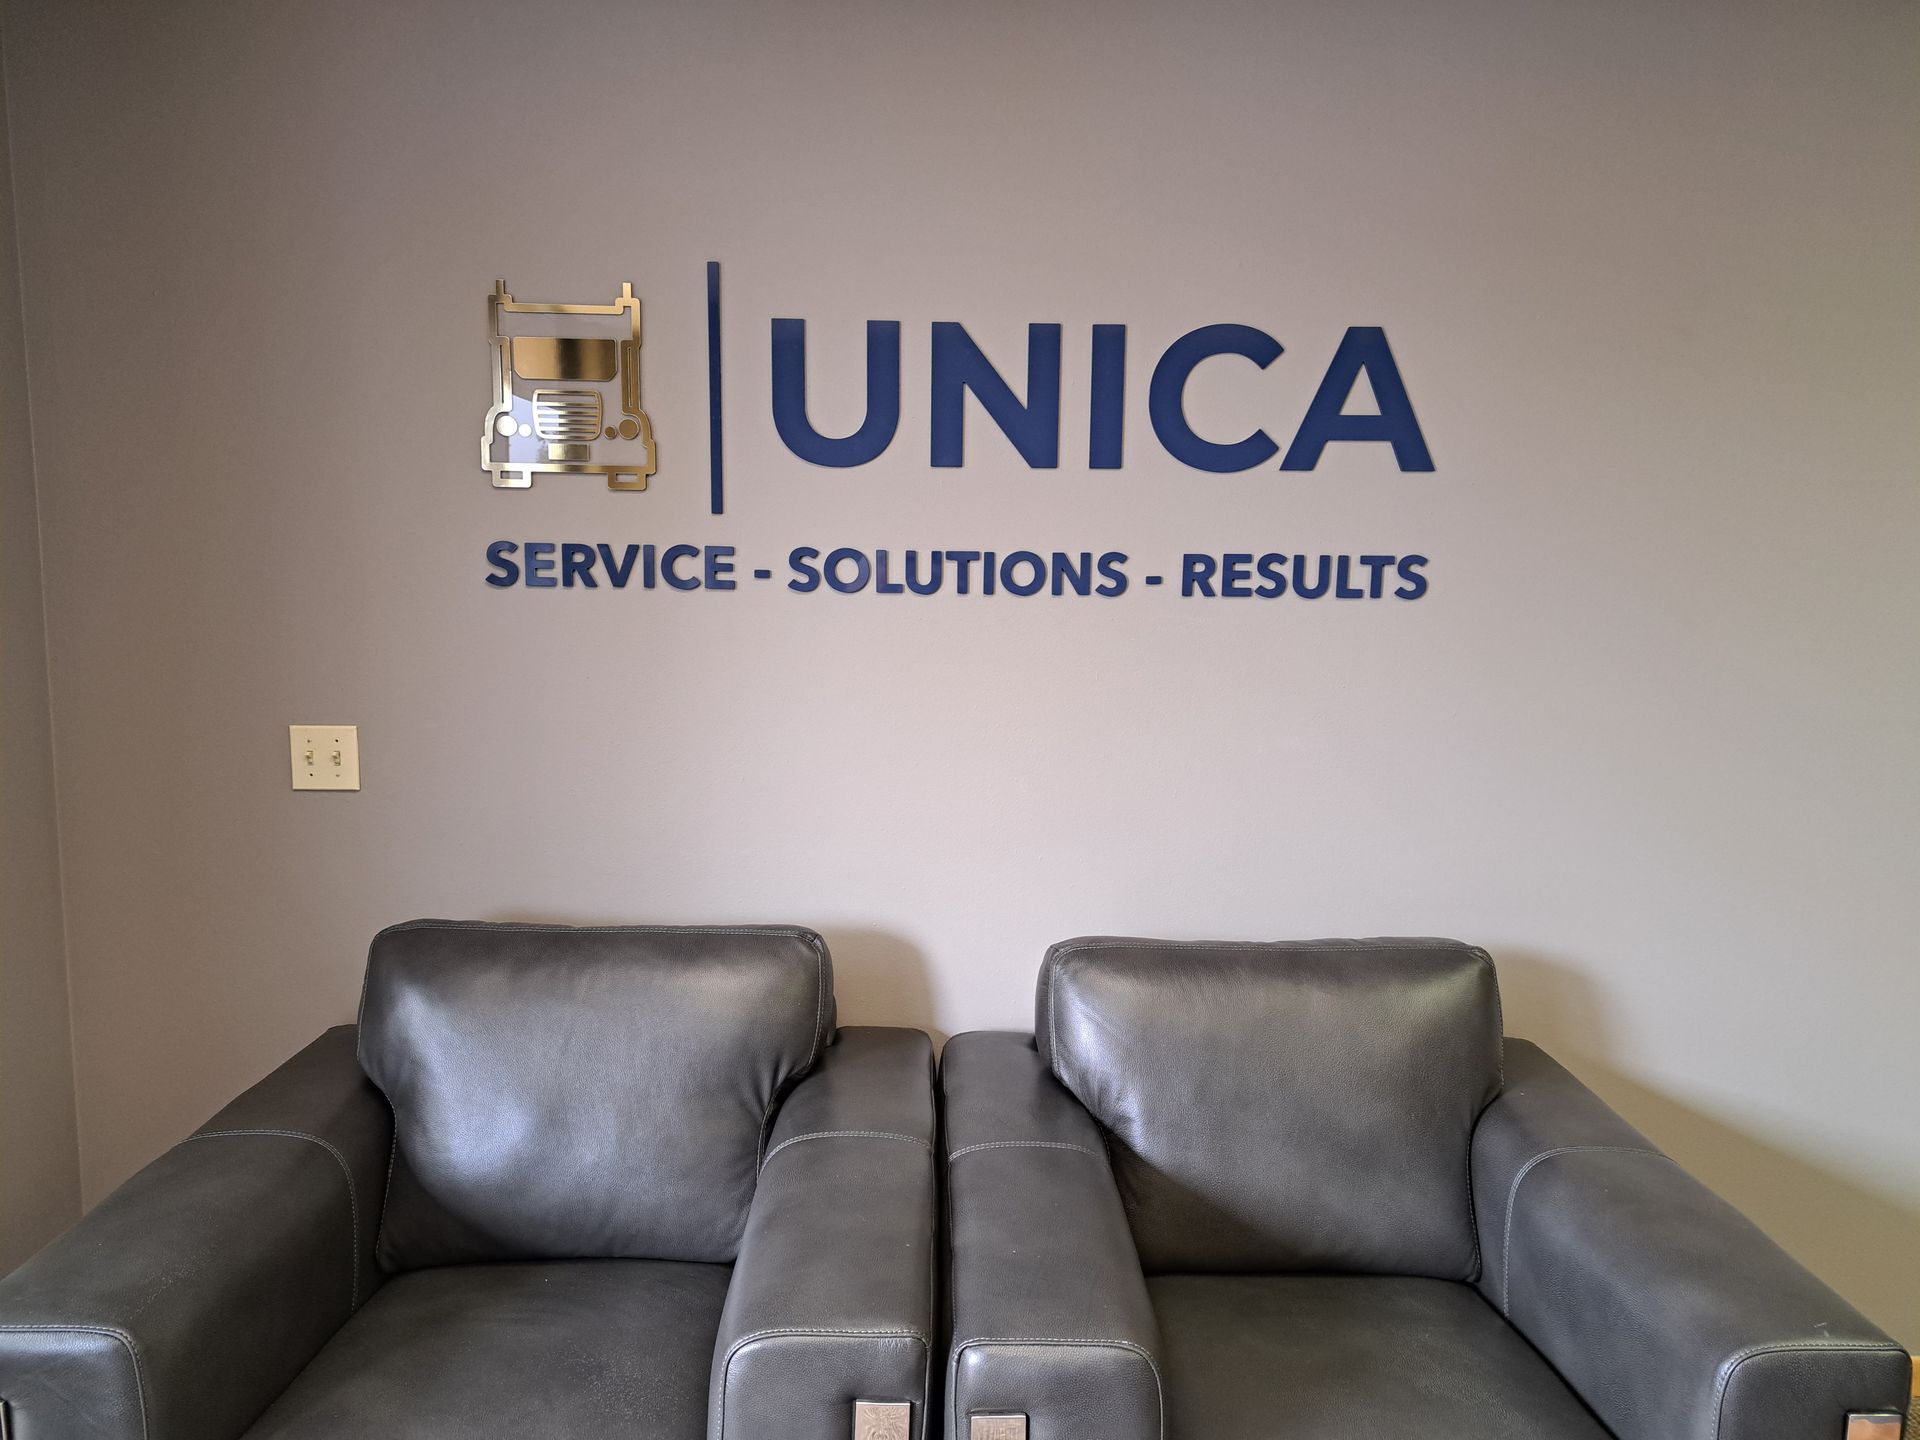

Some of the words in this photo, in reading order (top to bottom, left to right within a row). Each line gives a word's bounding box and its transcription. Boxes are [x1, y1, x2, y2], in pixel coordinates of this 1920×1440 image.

[771, 318, 1435, 473] UNICA
[486, 541, 736, 591] SERVICE
[787, 546, 1128, 598] SOLUTIONS
[1181, 552, 1429, 601] RESULTS
